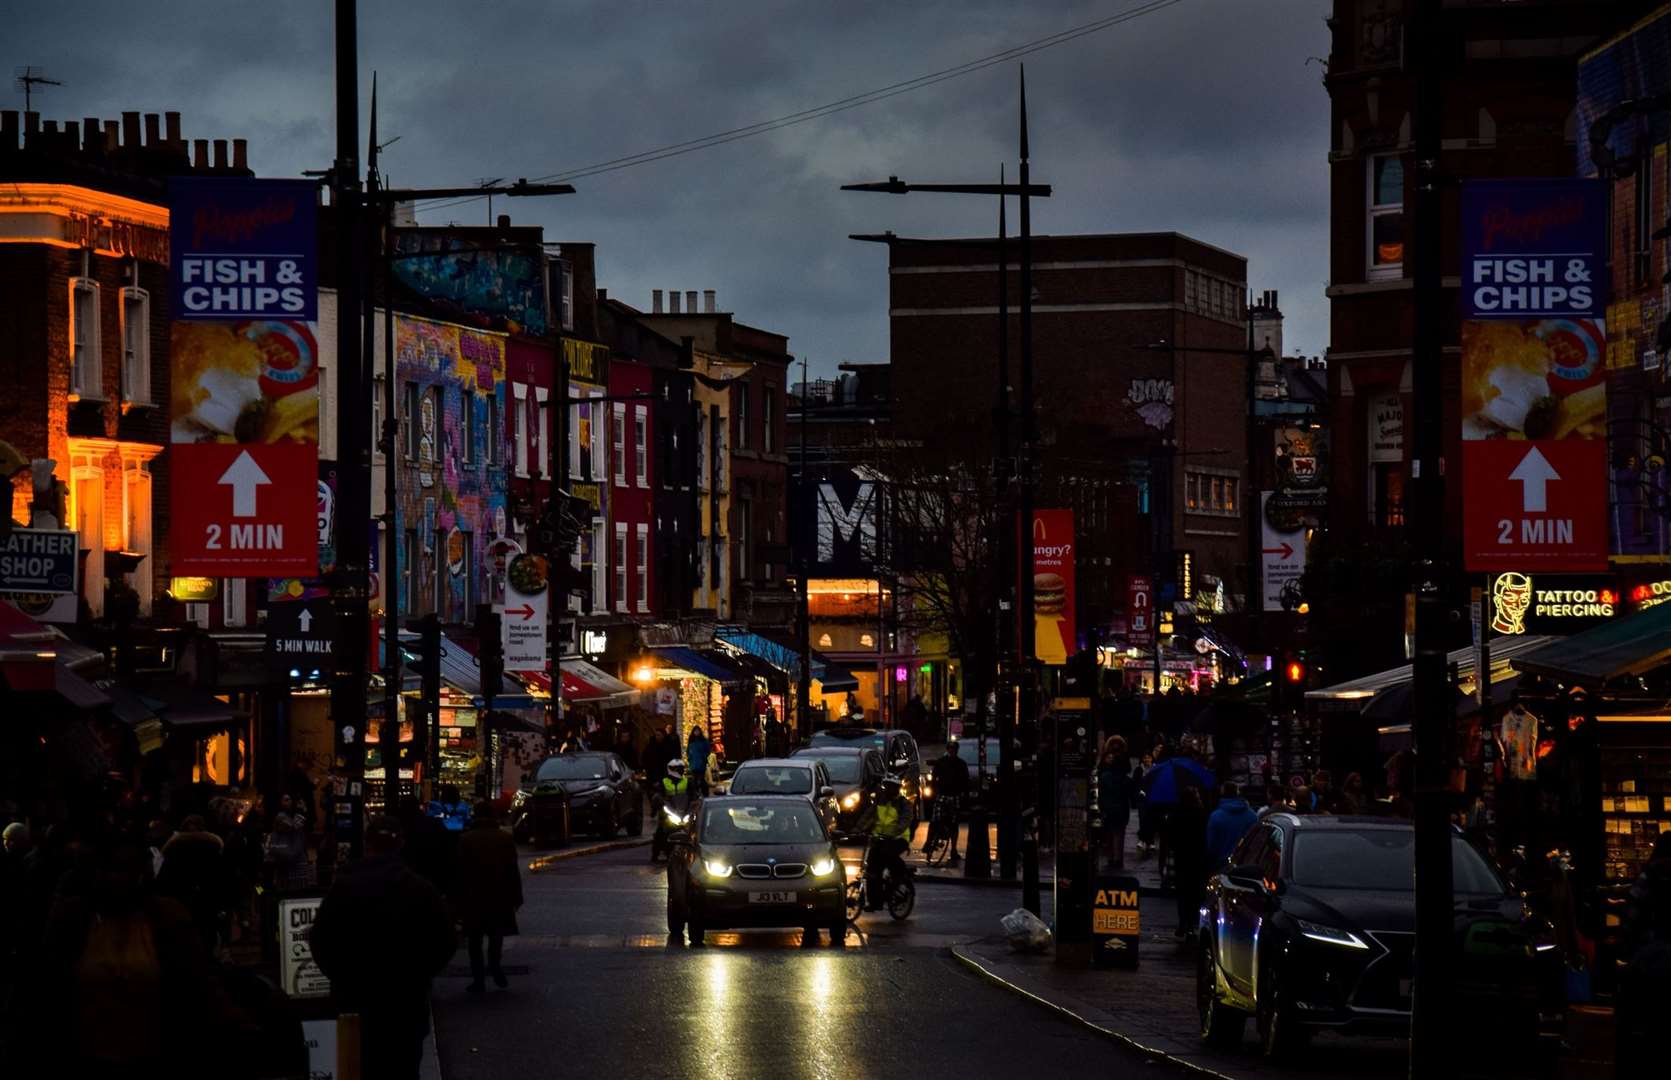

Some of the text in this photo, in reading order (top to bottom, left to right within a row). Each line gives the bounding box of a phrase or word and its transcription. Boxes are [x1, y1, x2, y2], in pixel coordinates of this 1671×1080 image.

[181, 259, 304, 285] FISH &
[1472, 259, 1593, 283] FISH &
[183, 286, 305, 312] CHIPS
[1473, 286, 1593, 310] CHIPS
[205, 523, 284, 550] 2 MIN
[1497, 519, 1574, 544] 2 MIN
[0, 556, 55, 577] SHOP
[1535, 590, 1599, 604] TATTOO
[1536, 603, 1615, 617] PIERCING
[275, 640, 332, 653] 5 MIN WALK
[1094, 889, 1138, 907] ATM
[1096, 914, 1137, 930] HERE
